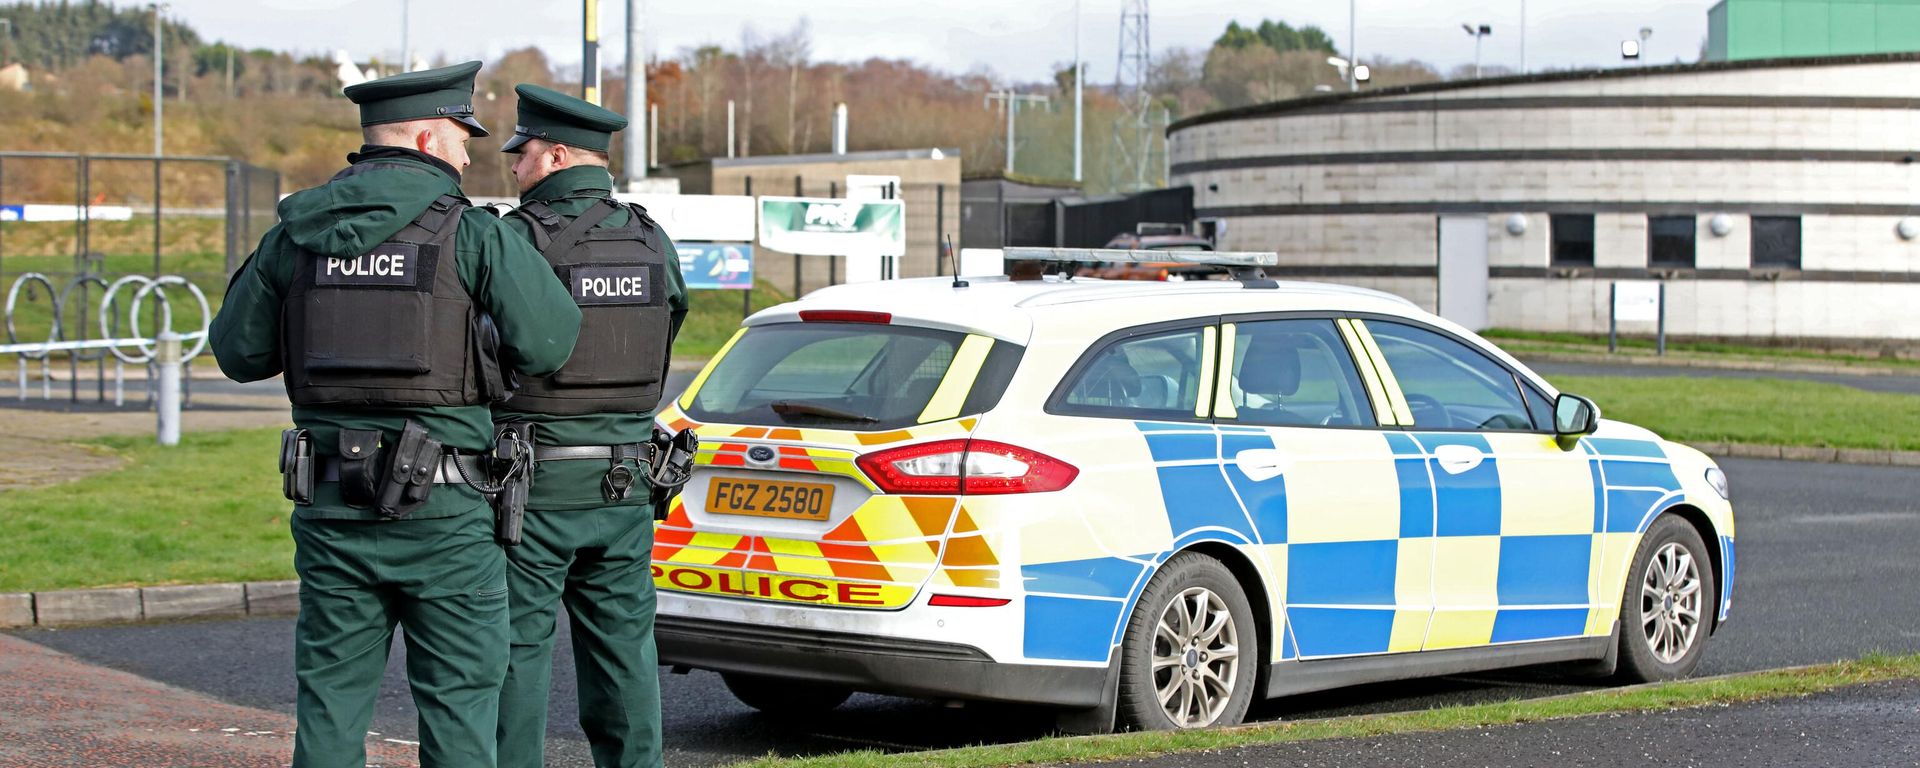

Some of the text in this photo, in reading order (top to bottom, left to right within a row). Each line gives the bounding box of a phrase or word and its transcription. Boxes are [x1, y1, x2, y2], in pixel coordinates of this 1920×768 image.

[327, 254, 405, 276] POLICE
[581, 277, 643, 297] POLICE
[714, 482, 824, 514] FGZ 2580
